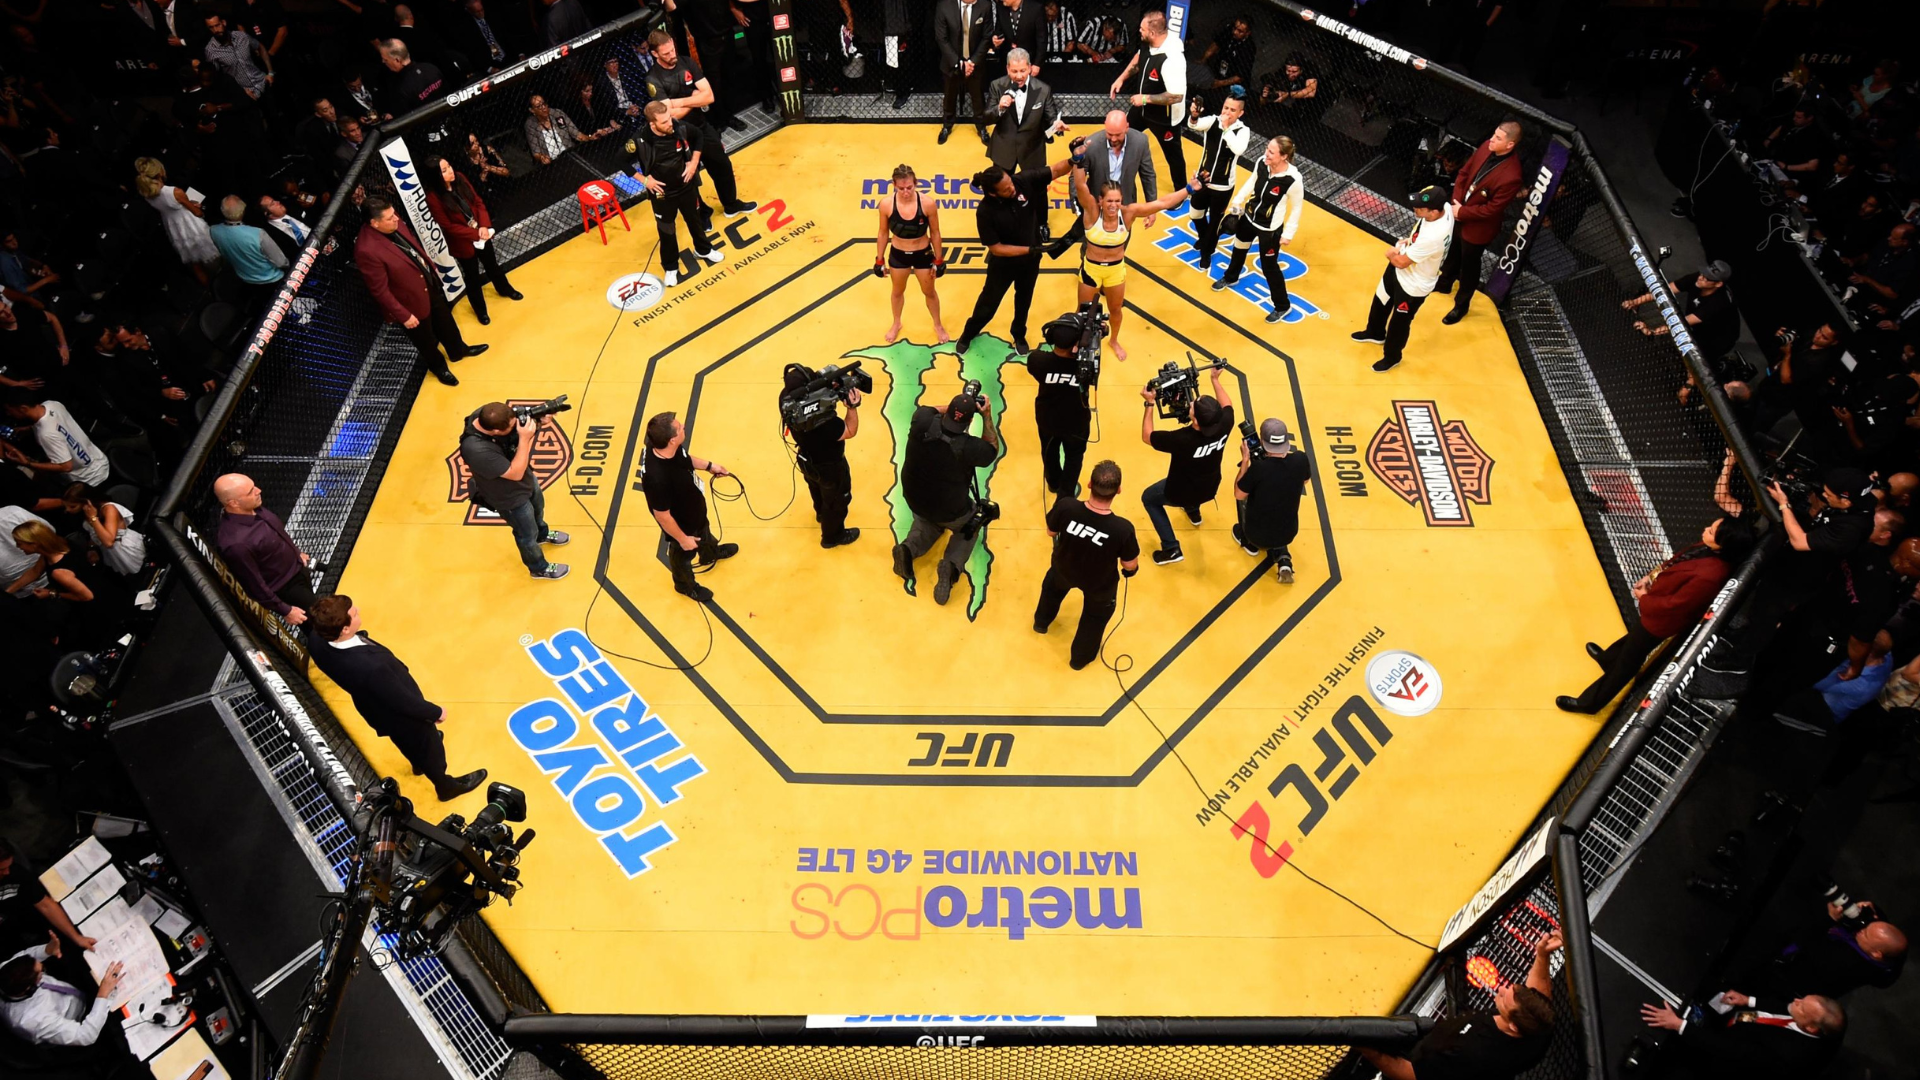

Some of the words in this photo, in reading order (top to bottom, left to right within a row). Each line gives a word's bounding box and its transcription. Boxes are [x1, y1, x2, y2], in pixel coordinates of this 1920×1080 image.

[1168, 5, 1184, 33] BU
[540, 48, 562, 66] UFC
[560, 44, 569, 56] 2
[1315, 14, 1412, 64] HARLEY-DAVIDSON.COM
[114, 59, 150, 71] ARE
[418, 79, 442, 100] SECURIT
[459, 84, 481, 102] UFC
[481, 80, 490, 93] 2
[586, 184, 610, 200] UFC
[404, 194, 425, 235] SHIPPING
[423, 235, 438, 260] LINES
[412, 187, 447, 254] HUDSON
[757, 199, 795, 233] 2
[1500, 166, 1553, 275] metroPCS
[633, 302, 673, 328] FINISH
[672, 289, 696, 305] THE
[696, 270, 728, 293] FIGHT
[733, 235, 791, 271] AVAILABLE
[790, 220, 816, 237] NOW
[942, 246, 990, 265] UF
[248, 290, 294, 356] T-MOBILE
[286, 247, 320, 292] ARENA
[618, 281, 652, 302] EA
[624, 285, 659, 307] SPORTS
[1661, 307, 1695, 357] ARENA
[803, 402, 819, 415] UFC
[570, 426, 615, 496] H-D.COM
[1193, 434, 1228, 458] UFC
[1324, 427, 1368, 497] H-D.COM
[1376, 432, 1417, 491] CYCLES
[1402, 407, 1462, 519] HARLEY-DAVIDSON
[1445, 432, 1484, 491] MOTOR
[1066, 520, 1110, 547] UFC
[186, 525, 261, 616] KINGDOM
[278, 630, 304, 661] DIRECTV
[1345, 625, 1386, 666] FINISH
[1324, 662, 1352, 688] THE
[1376, 657, 1412, 695] SPORTS
[1387, 665, 1429, 701] EA
[525, 628, 709, 808] TIRES
[1293, 684, 1330, 722] FIGHT
[907, 732, 1015, 767] UFC
[1225, 723, 1291, 793] AVAILABLE
[1267, 695, 1394, 837] UFC
[506, 697, 679, 880] TOYO
[1195, 789, 1232, 827] NOW
[1230, 800, 1295, 879] 2
[797, 847, 855, 872] LTE
[867, 849, 912, 874] 4G
[923, 850, 1138, 876] NATIONWIDE
